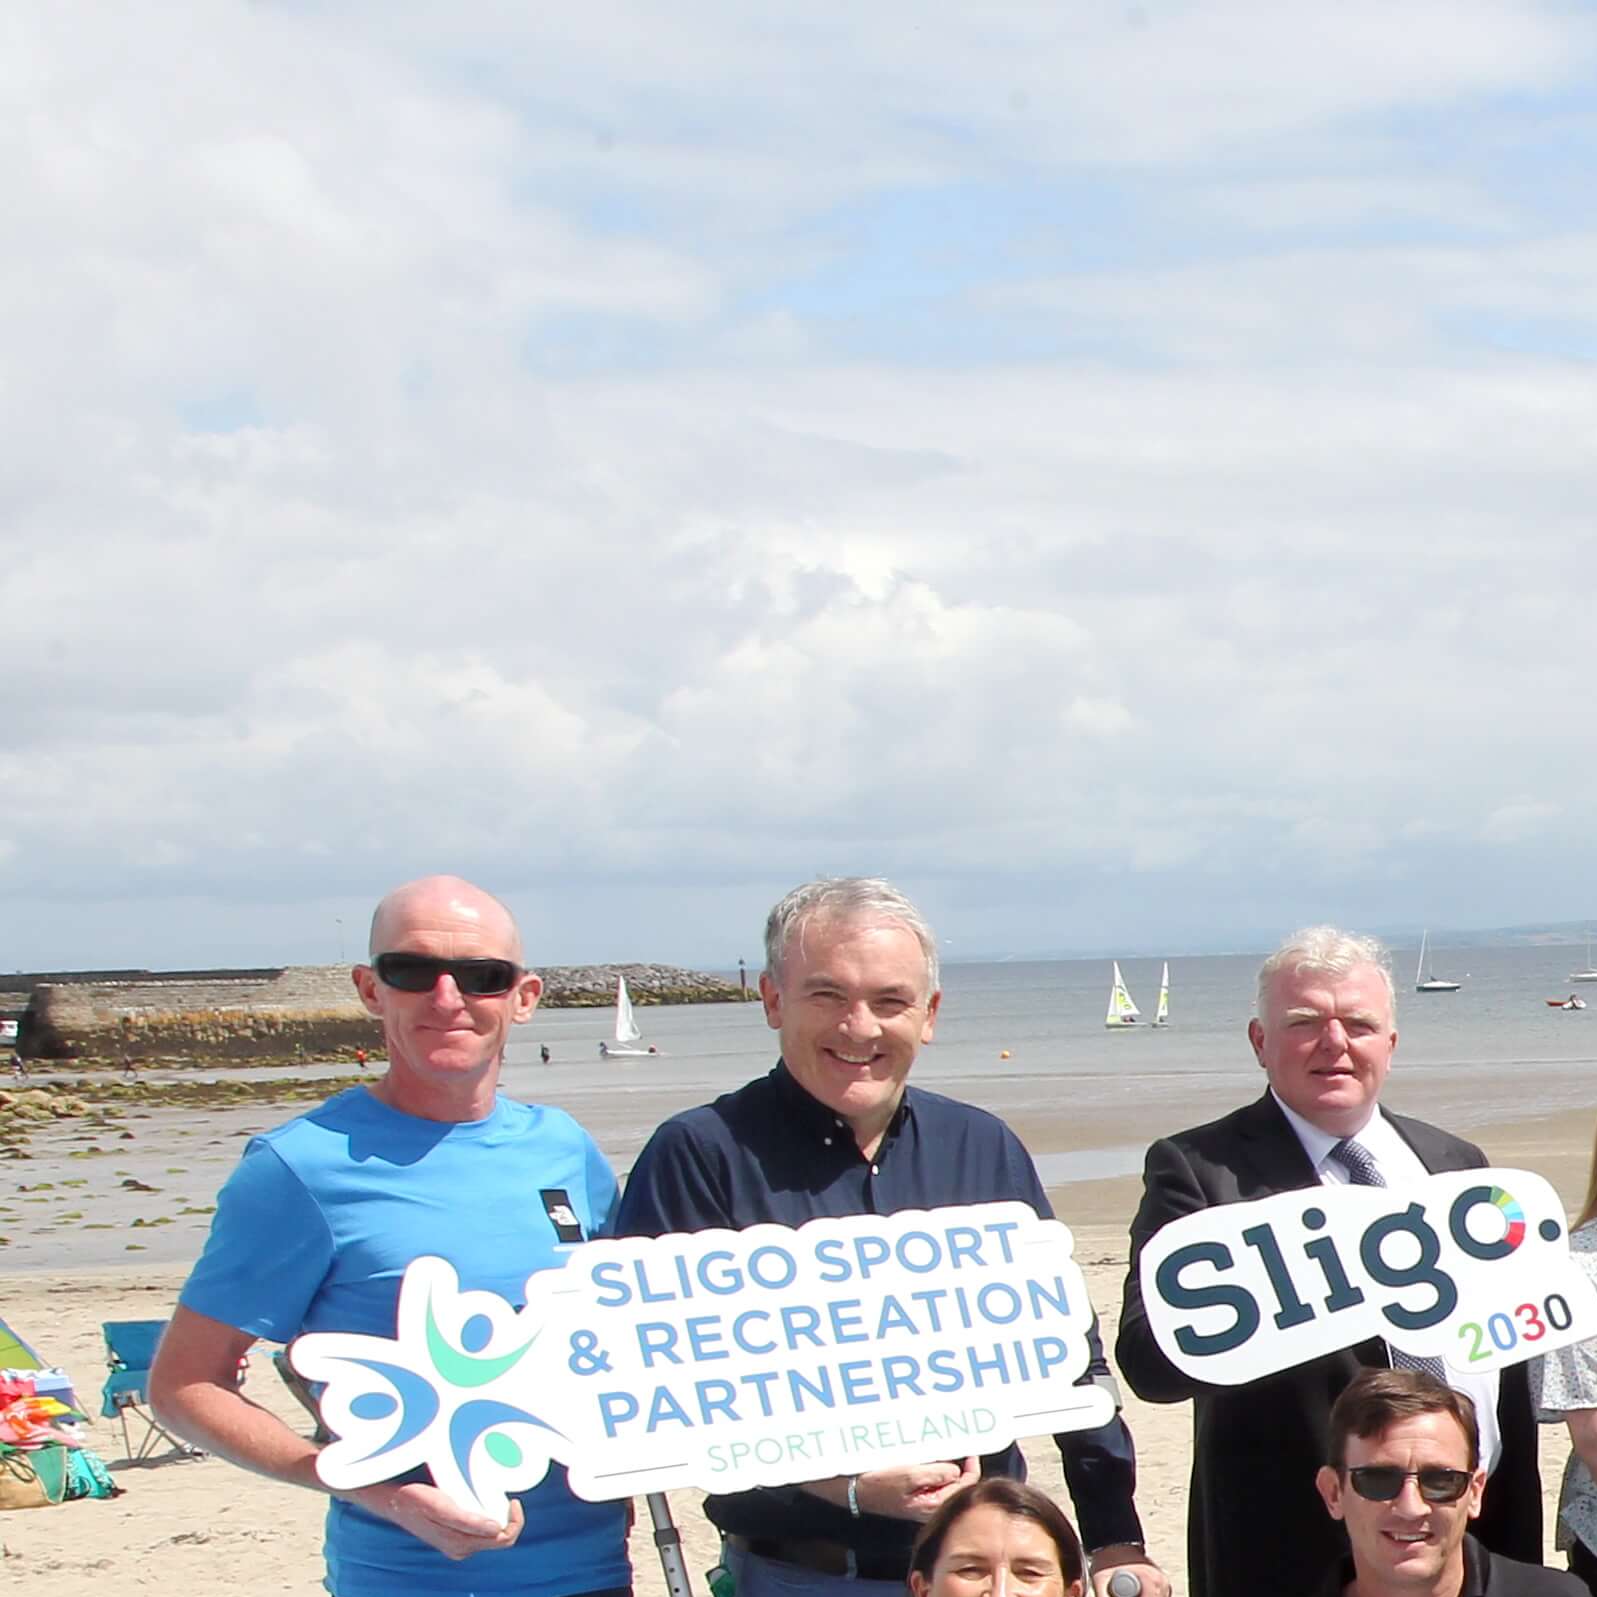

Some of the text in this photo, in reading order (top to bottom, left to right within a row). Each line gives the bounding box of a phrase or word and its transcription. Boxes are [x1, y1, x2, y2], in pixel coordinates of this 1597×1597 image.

[593, 1221, 1020, 1308] SLIGO SPORT
[1155, 1184, 1562, 1357] Sligo.
[568, 1275, 1073, 1377] & RECREATION
[1458, 1293, 1573, 1363] 2030
[597, 1335, 1069, 1439] PARTNERSHIP
[705, 1407, 997, 1473] SPORT IRELAND
